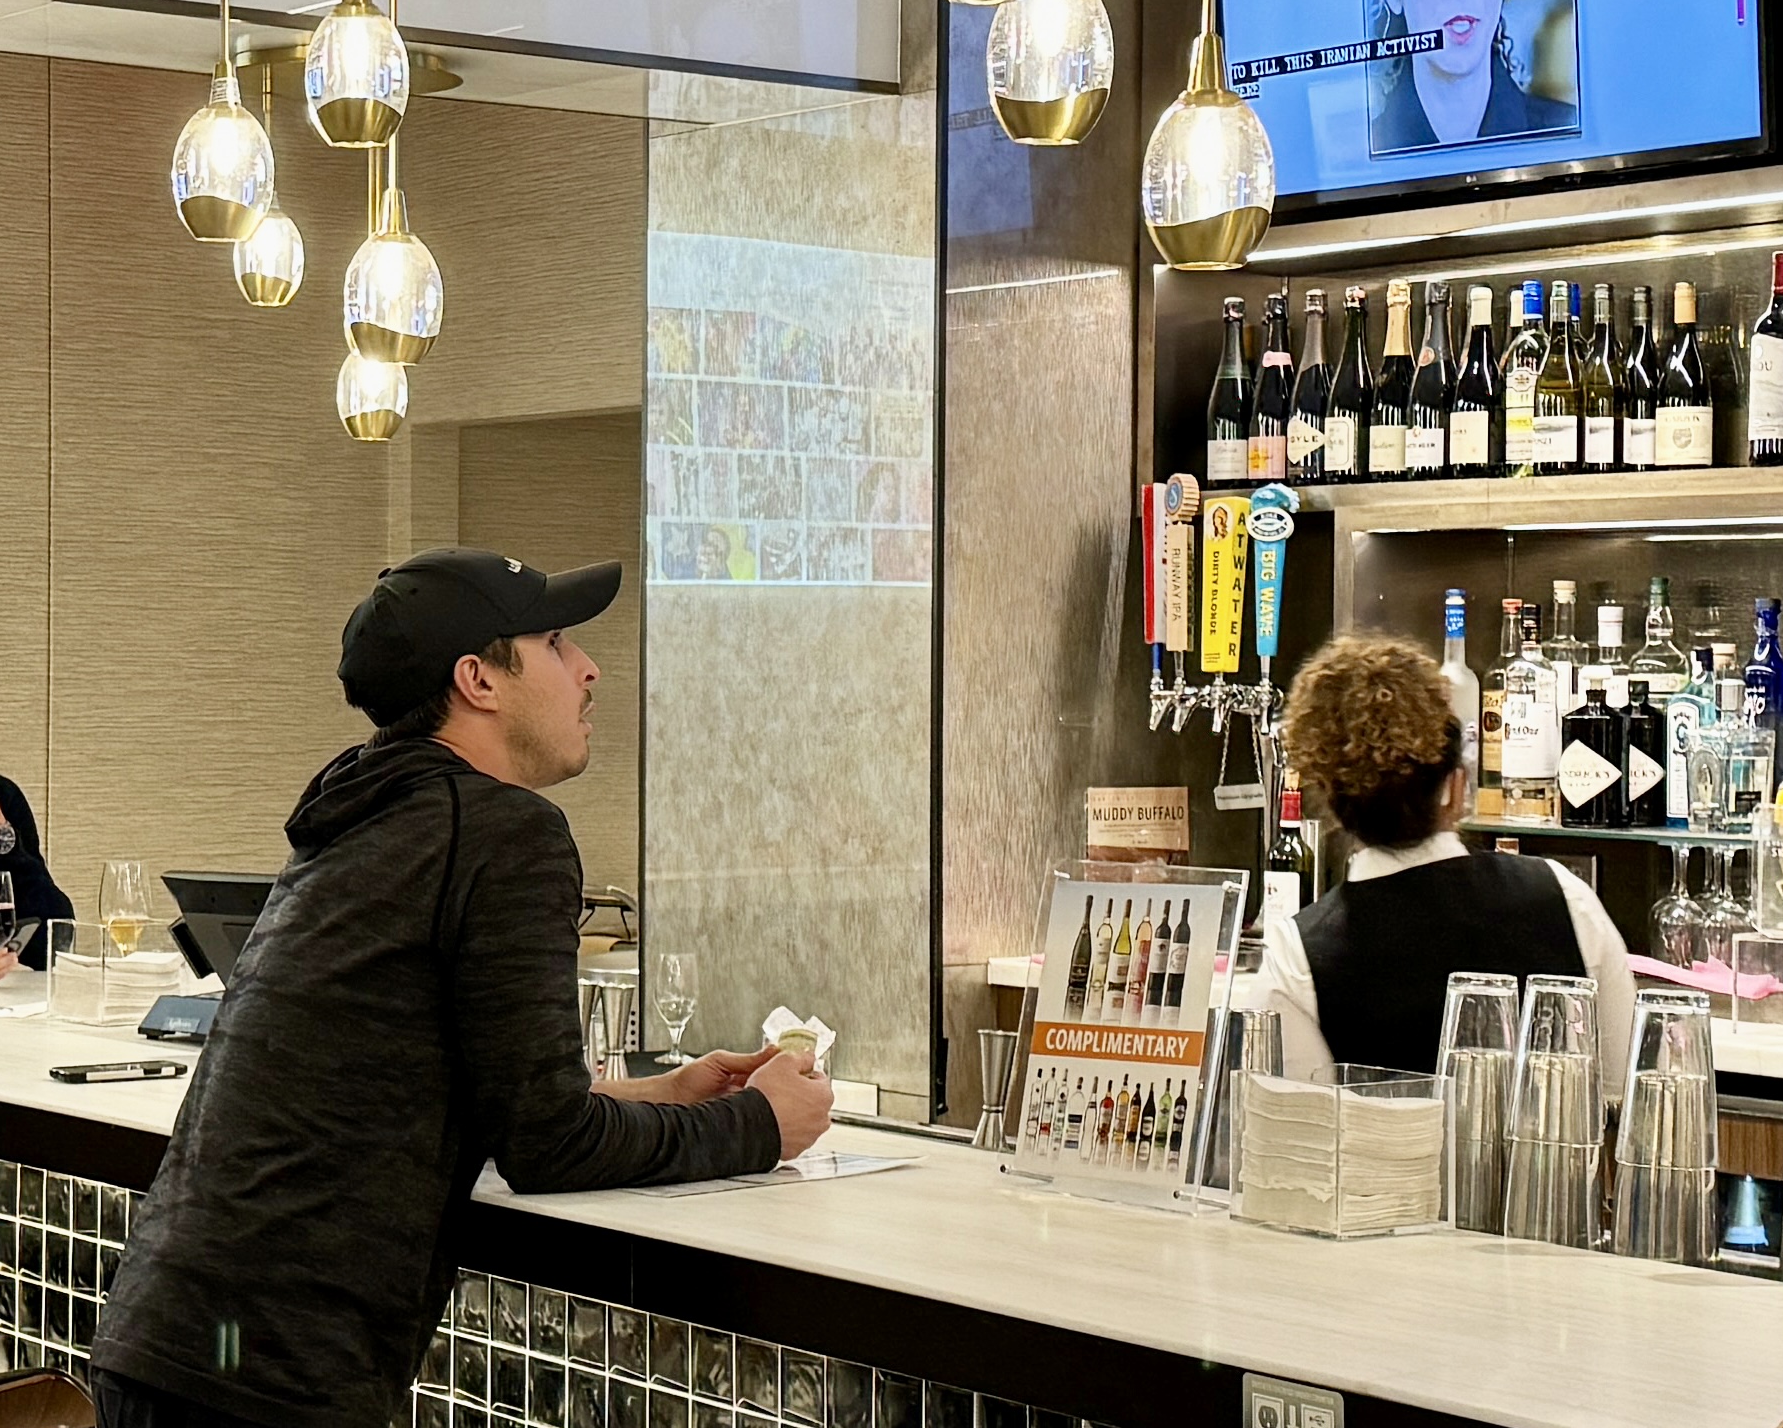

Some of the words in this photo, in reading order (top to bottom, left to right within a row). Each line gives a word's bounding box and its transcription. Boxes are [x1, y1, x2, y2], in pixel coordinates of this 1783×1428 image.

[1232, 64, 1246, 80] TO
[1251, 59, 1280, 76] KILL
[1285, 53, 1314, 71] THIS
[1320, 43, 1371, 65] IRANIAN
[1376, 32, 1437, 57] ACTIVIST
[1171, 548, 1181, 597] RUNWAY
[1212, 551, 1220, 585] DIRTY
[1229, 512, 1246, 657] ATWATER
[1261, 550, 1277, 581] BIG
[1171, 600, 1182, 621] IPA
[1209, 589, 1219, 635] BLONDE
[1260, 587, 1275, 637] WAVE
[1092, 807, 1134, 821] MUDDY
[1137, 806, 1185, 821] BUFFALO
[1045, 1027, 1189, 1059] COMPLIMENTARY
